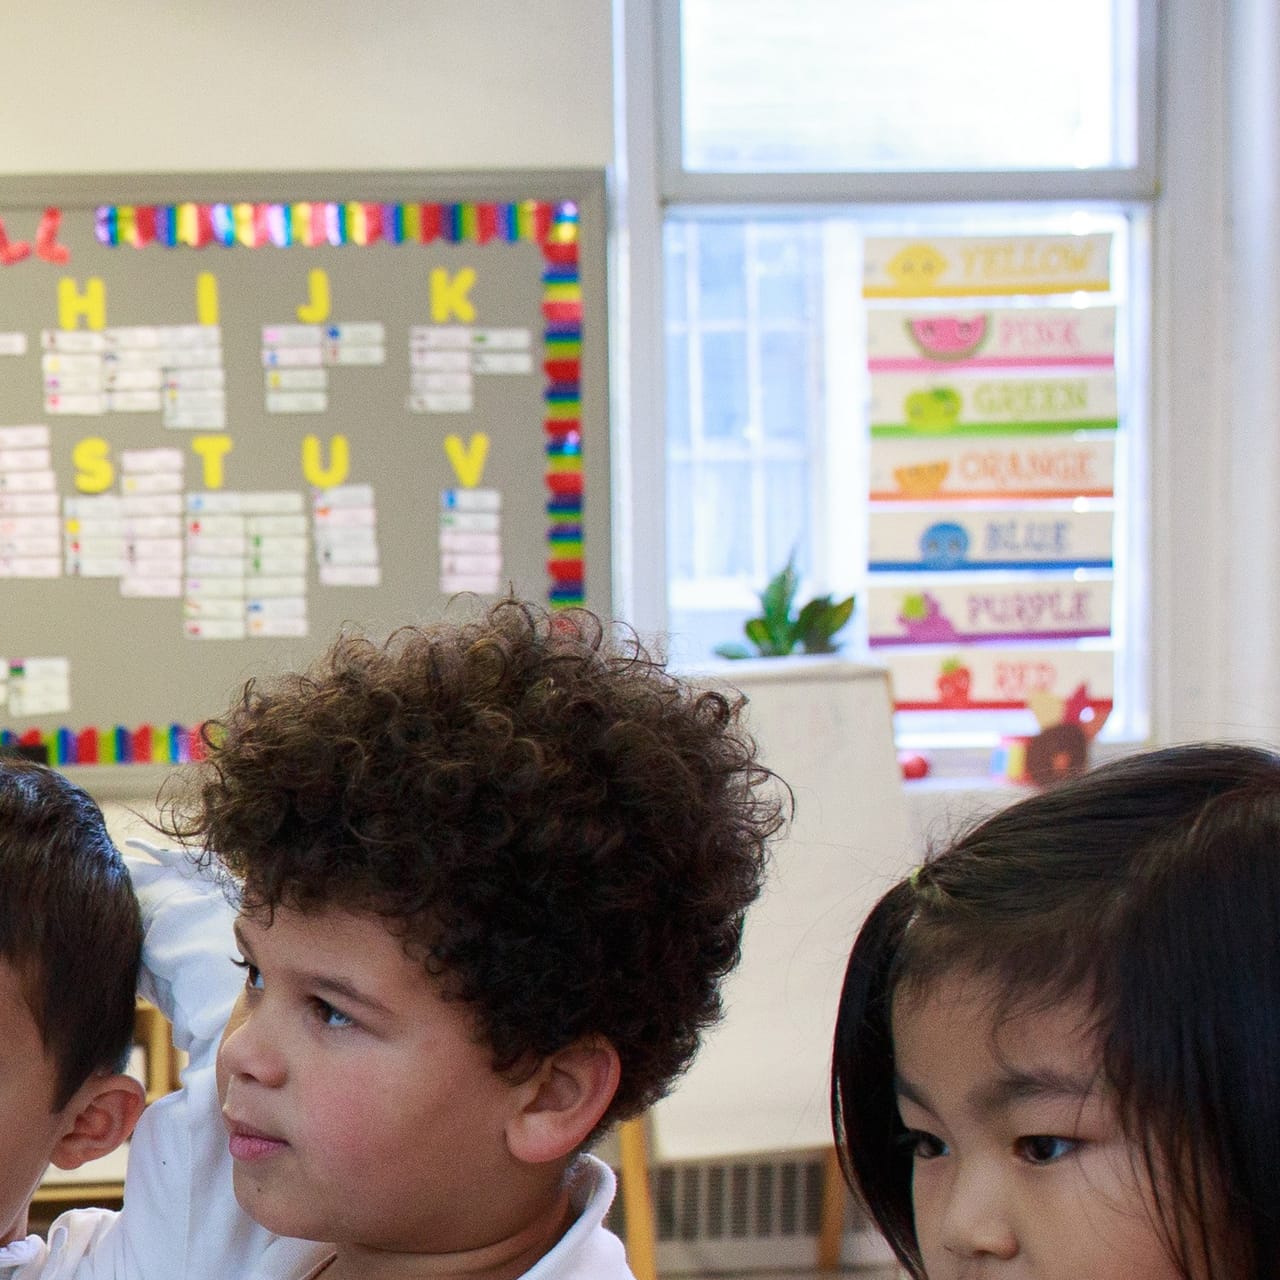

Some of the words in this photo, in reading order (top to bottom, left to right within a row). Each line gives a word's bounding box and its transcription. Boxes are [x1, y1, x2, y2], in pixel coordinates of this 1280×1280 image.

[960, 242, 1094, 278] YELLOW
[57, 277, 107, 332] H
[195, 271, 220, 326] I
[295, 268, 331, 325] J
[429, 267, 478, 324] K
[999, 316, 1081, 347] PINK
[973, 377, 1088, 416] GREEN
[72, 437, 115, 495] S
[190, 433, 233, 490] T
[301, 433, 350, 490] U
[443, 432, 490, 489] V
[959, 451, 1095, 482] ORANGE
[985, 520, 1070, 553] BLUE
[968, 588, 1092, 625] PURPLE
[994, 661, 1056, 693] RED
